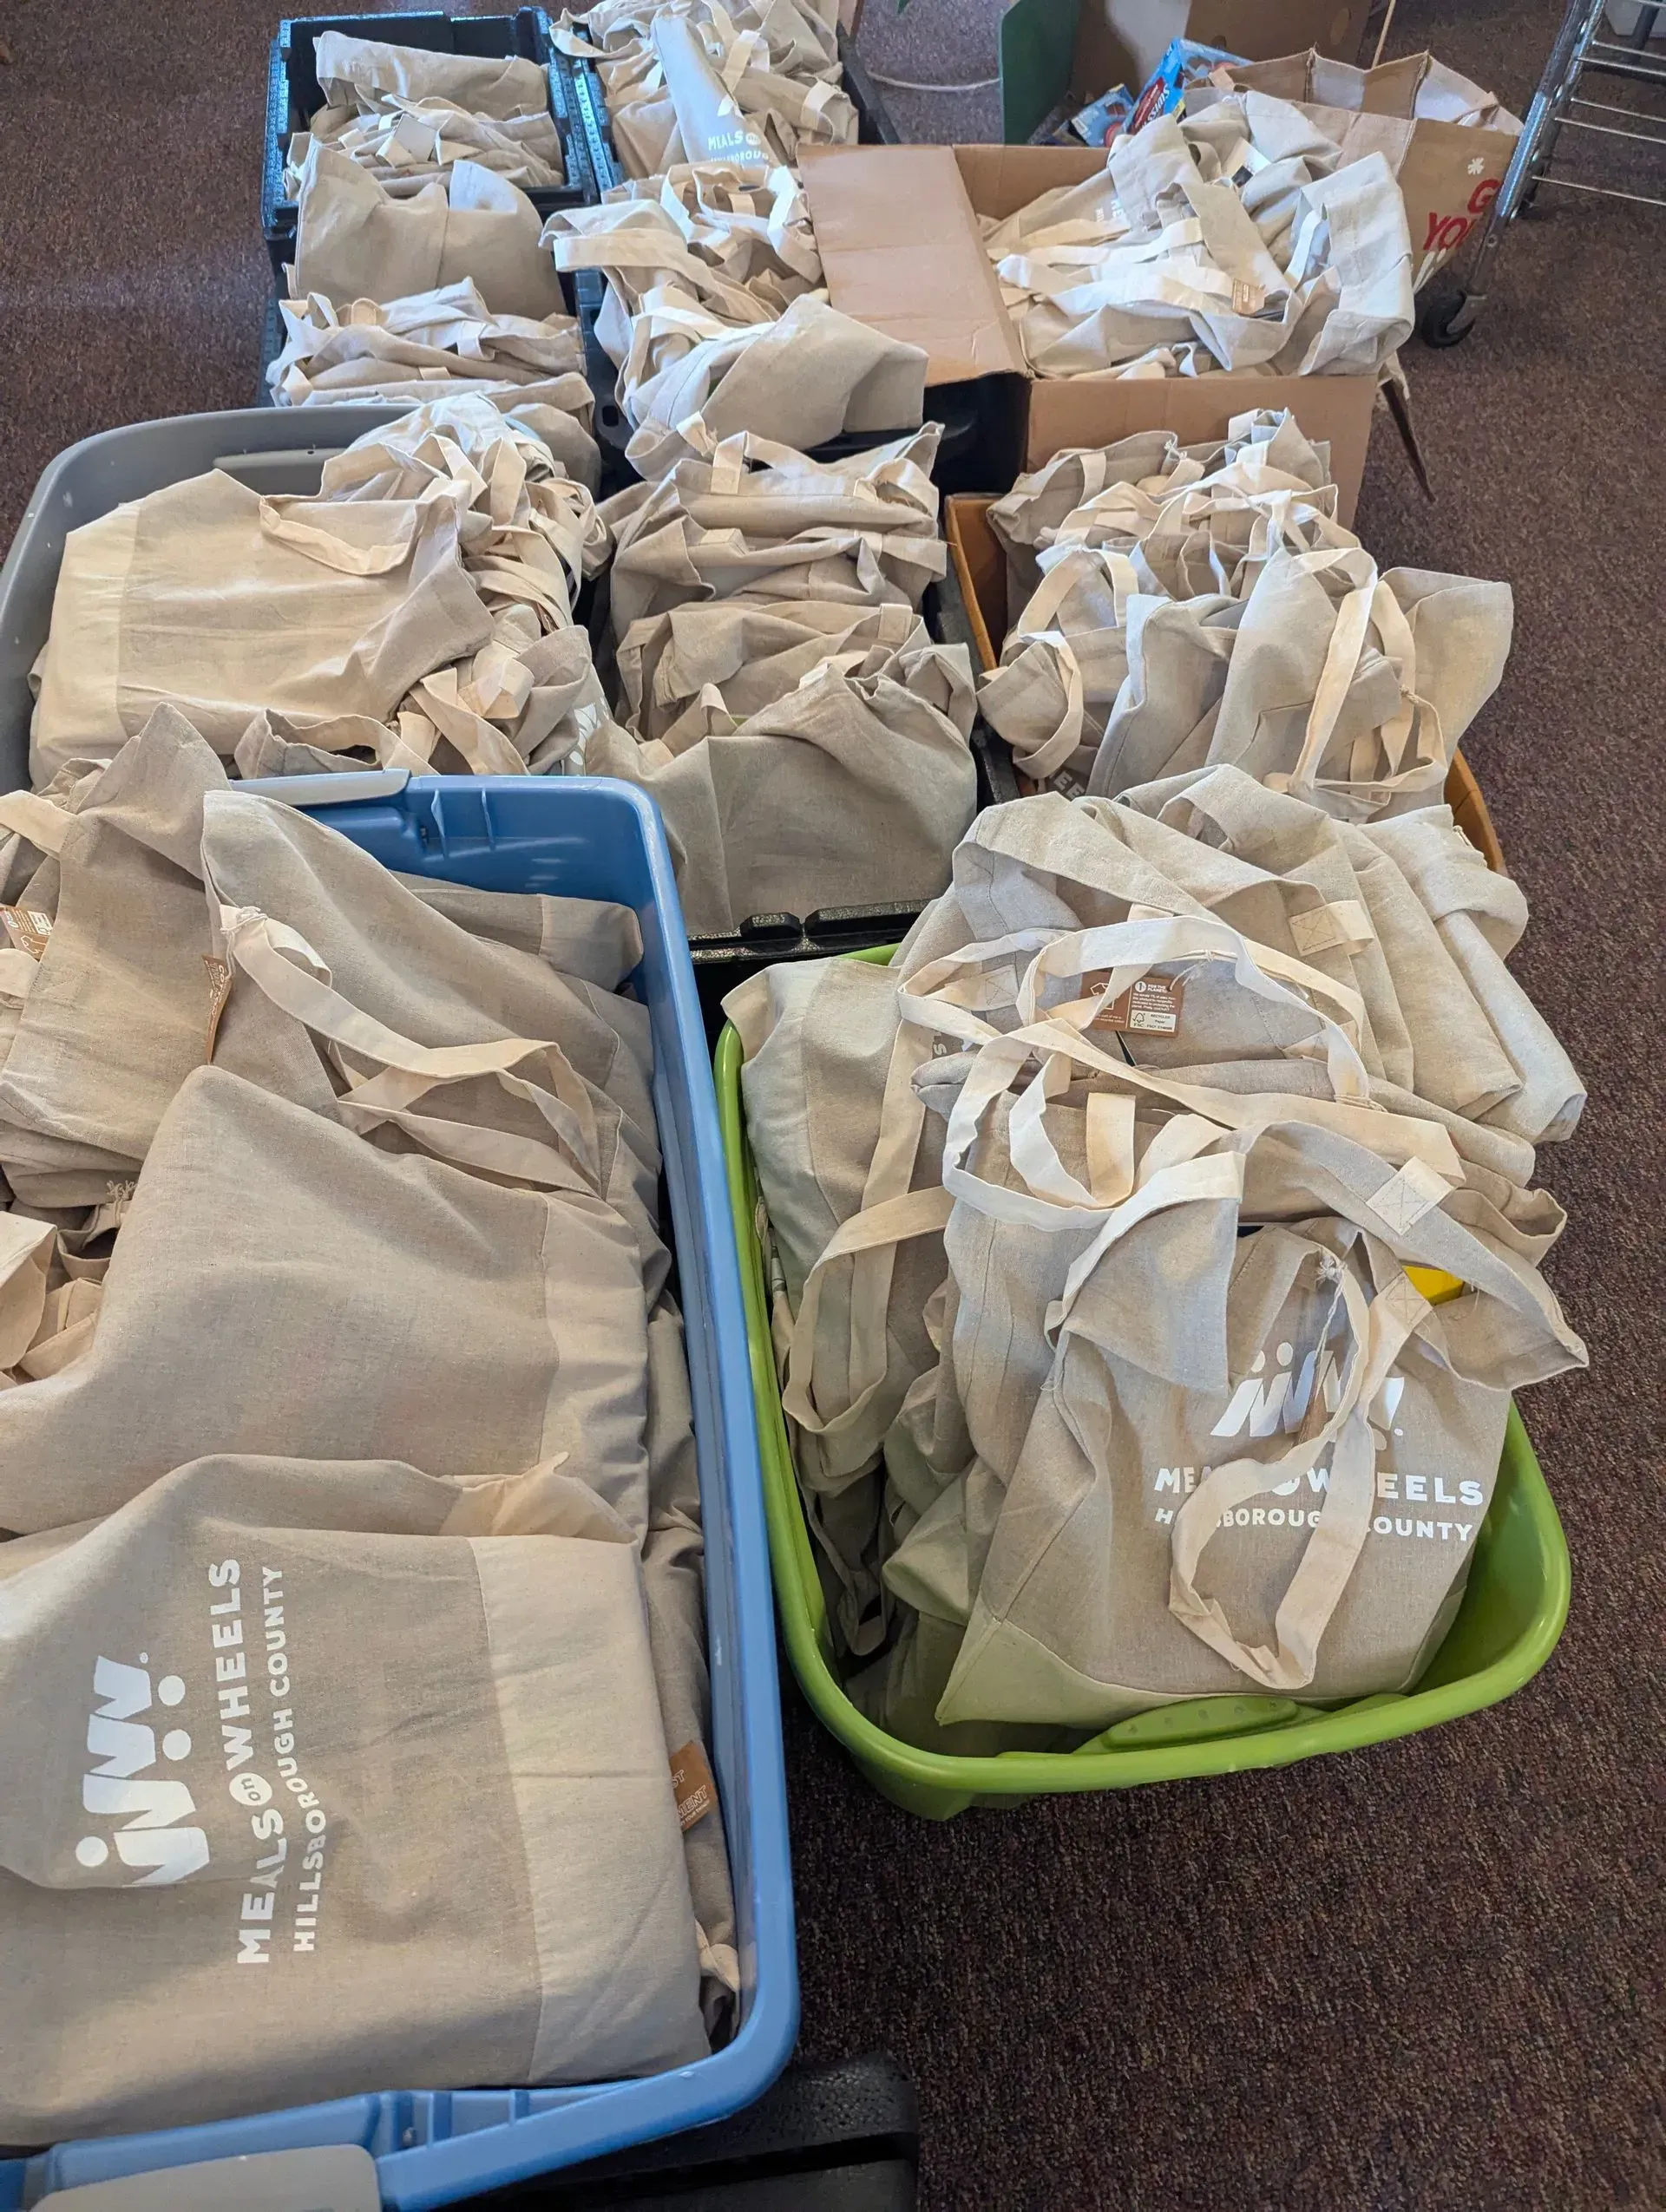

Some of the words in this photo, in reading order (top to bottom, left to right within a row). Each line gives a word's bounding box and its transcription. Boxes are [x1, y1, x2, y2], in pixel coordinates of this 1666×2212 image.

[1307, 1467, 1484, 1506] WEELS
[1368, 1516, 1473, 1541] OUNTY
[208, 1559, 254, 1770] WHEELS
[261, 1566, 291, 1698] COUNTY
[237, 1809, 287, 1964] MEALS
[273, 1707, 326, 1952] HILLSBOROUGH
